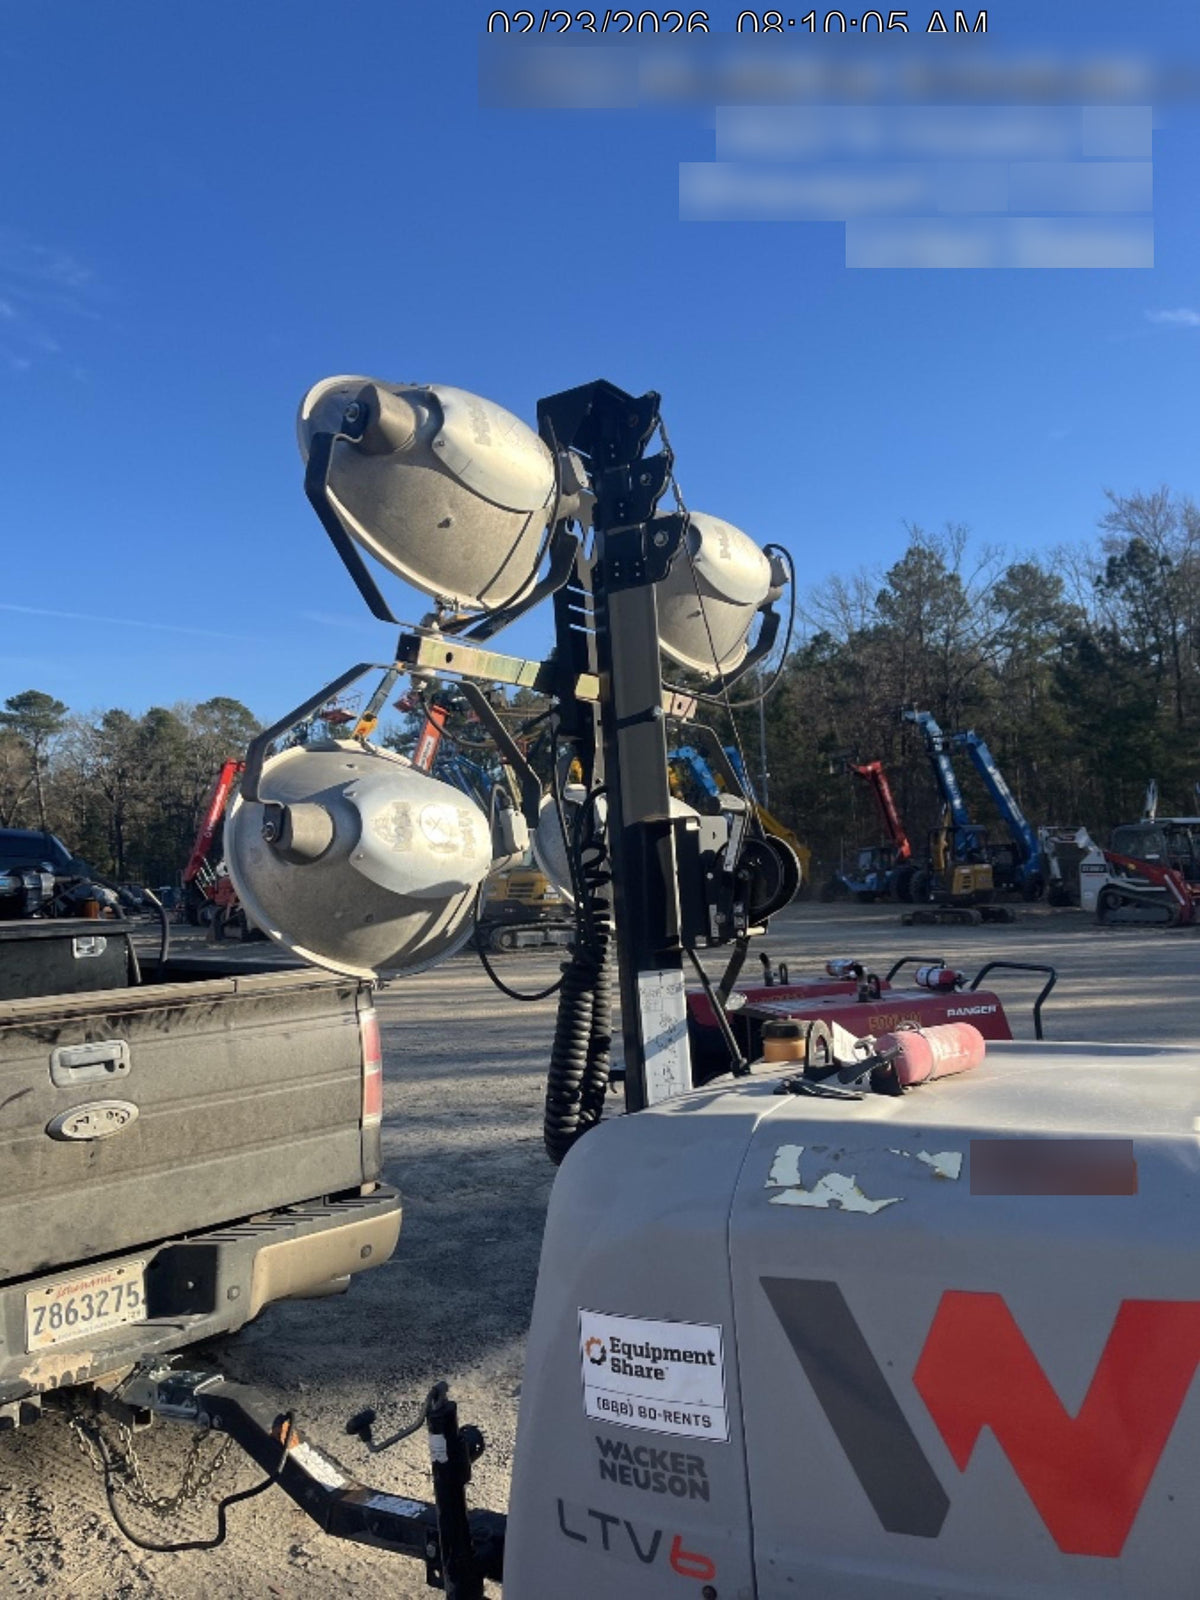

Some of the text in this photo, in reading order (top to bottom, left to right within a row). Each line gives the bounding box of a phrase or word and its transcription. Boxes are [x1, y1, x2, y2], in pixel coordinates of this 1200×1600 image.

[946, 1004, 998, 1017] RANGER
[609, 1336, 717, 1366] Equipment
[611, 1357, 665, 1380] Share
[595, 1435, 708, 1478] WACKER
[599, 1459, 710, 1502] NEUSON
[557, 1498, 716, 1581] LTV6
